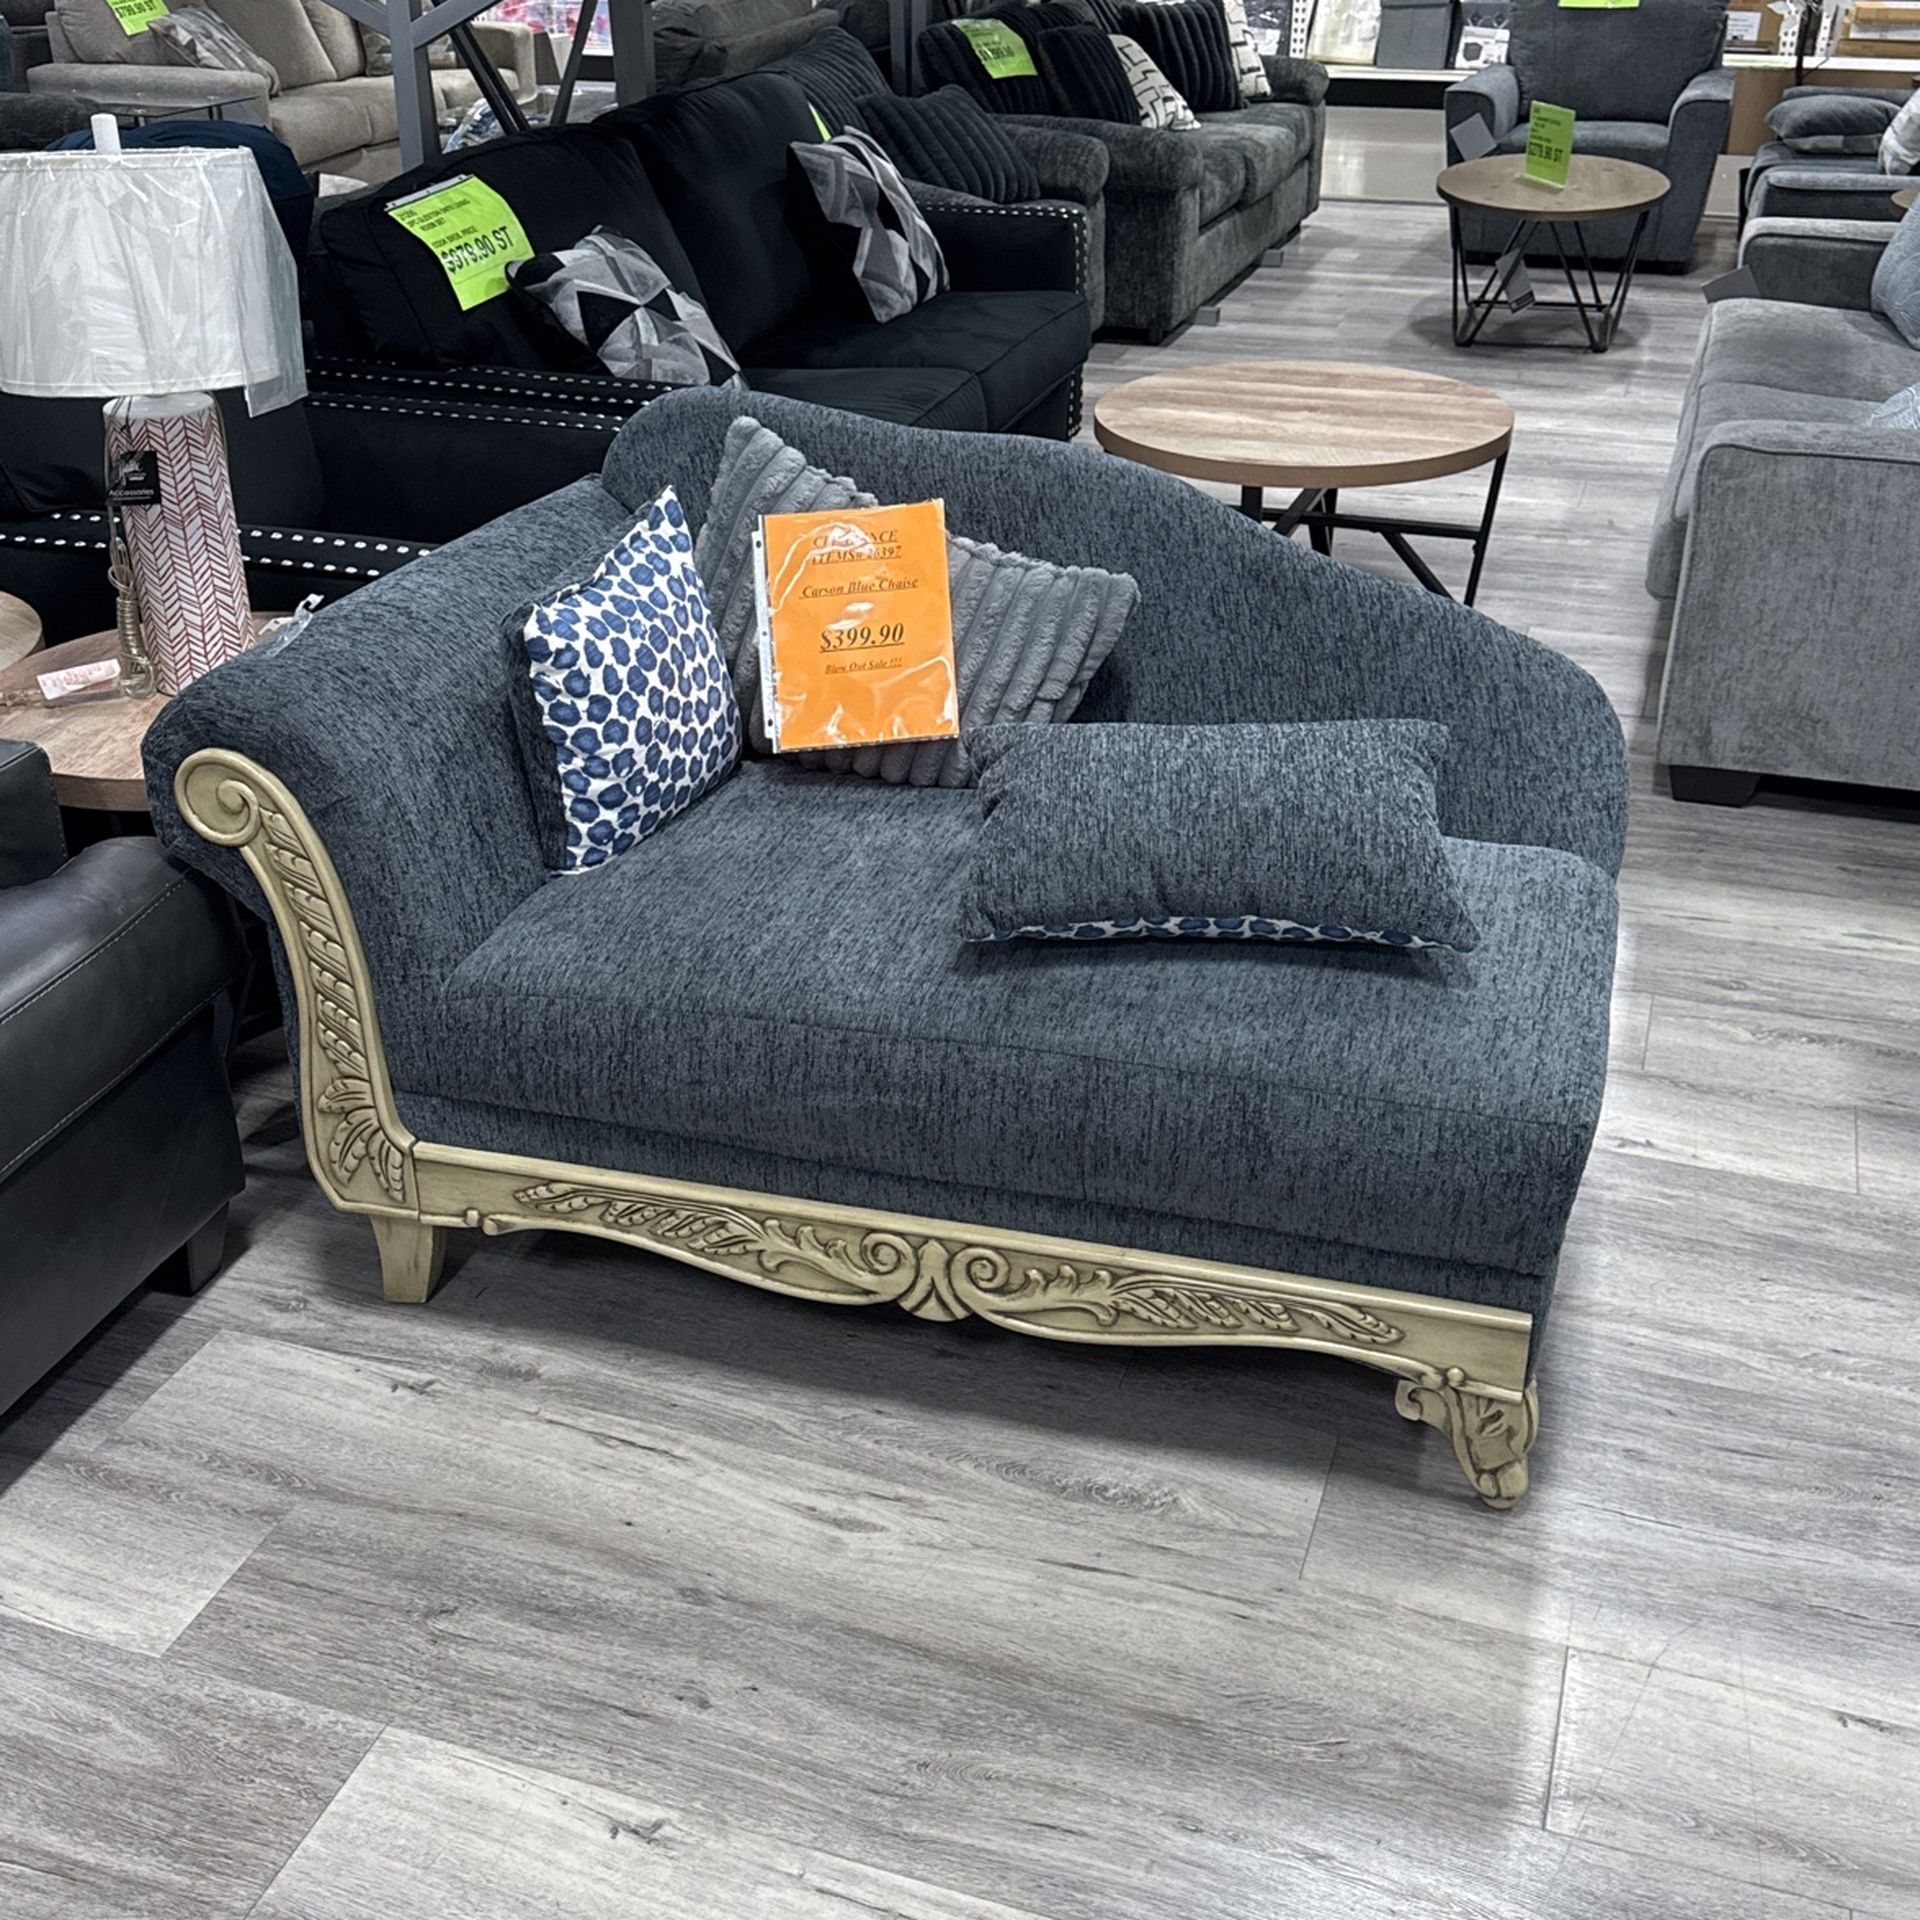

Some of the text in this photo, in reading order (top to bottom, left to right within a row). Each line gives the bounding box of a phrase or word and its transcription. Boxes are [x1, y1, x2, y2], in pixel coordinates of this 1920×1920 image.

[492, 225, 513, 250] ST
[109, 489, 154, 497] Accessories
[802, 576, 919, 598] Carson Blue Chaise
[821, 622, 905, 651] $399.90
[849, 662, 867, 672] Out
[867, 659, 888, 670] Sale
